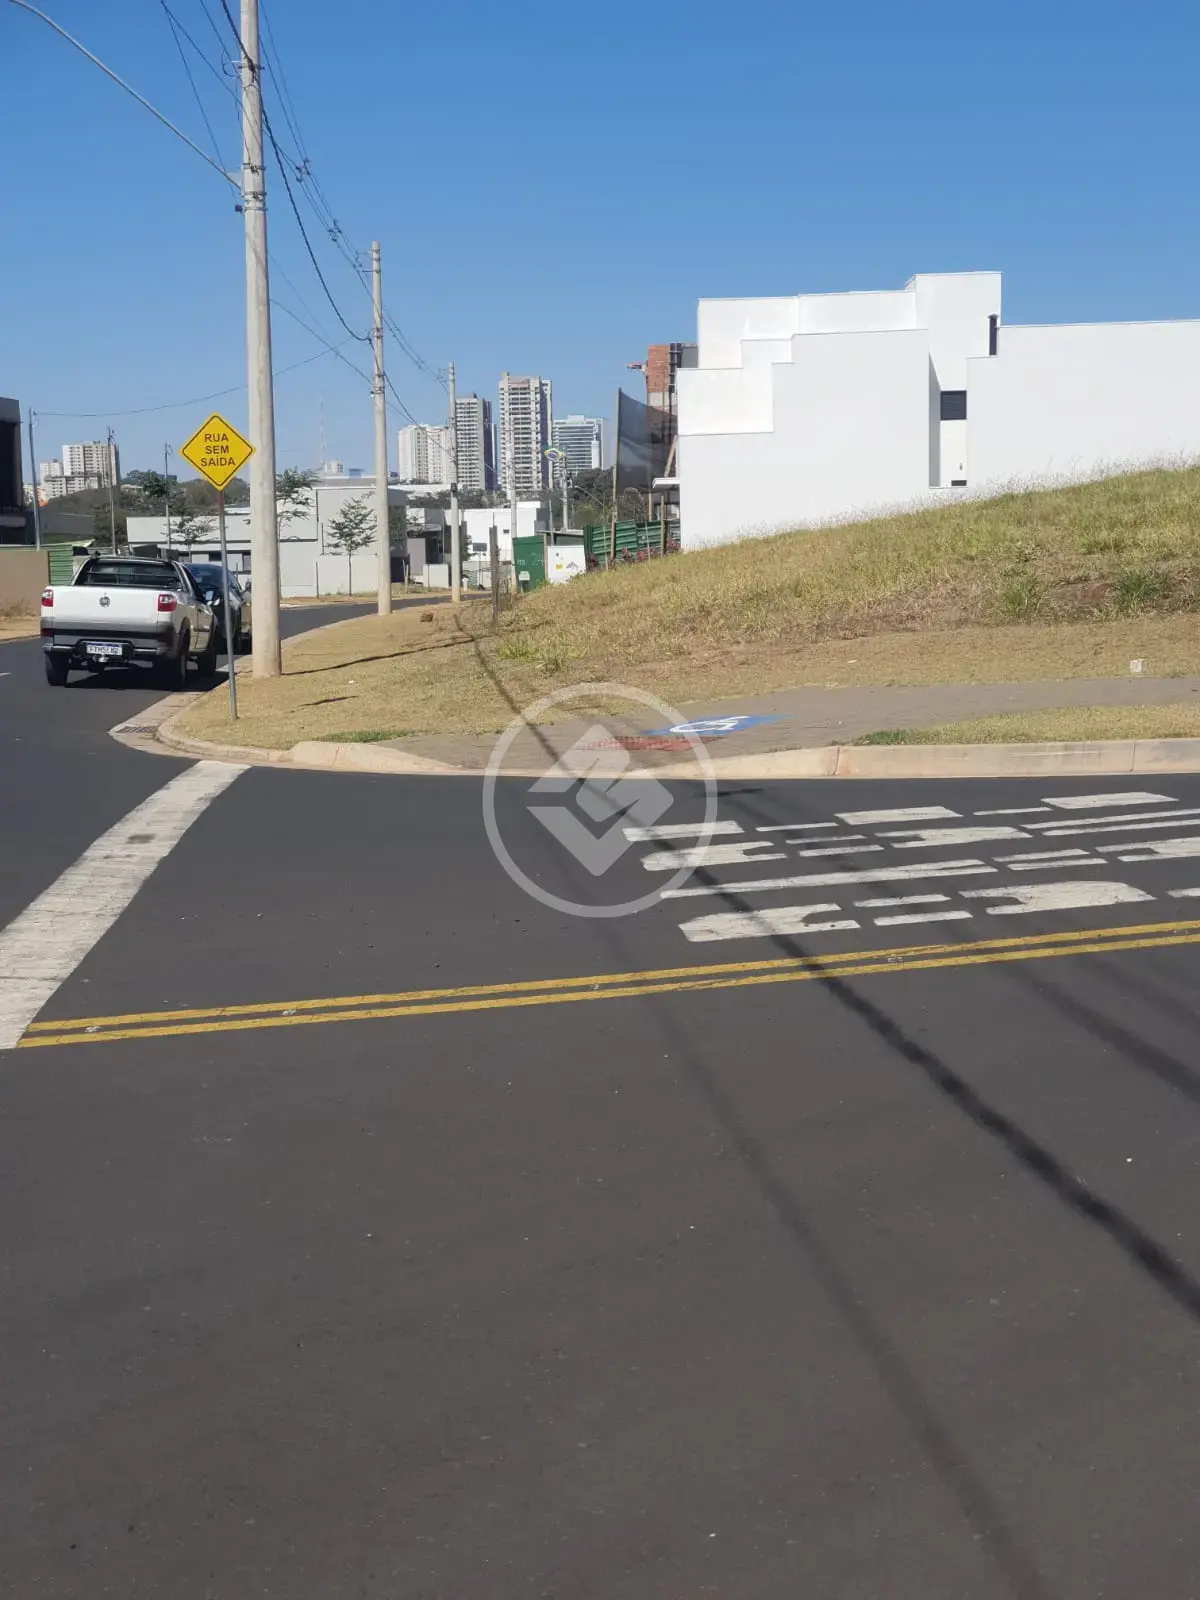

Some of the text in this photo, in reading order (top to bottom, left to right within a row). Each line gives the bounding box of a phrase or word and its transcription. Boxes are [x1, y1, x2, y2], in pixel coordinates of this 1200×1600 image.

[204, 433, 229, 442] RUA
[205, 445, 229, 454] SEM
[200, 456, 236, 466] SAÍDA
